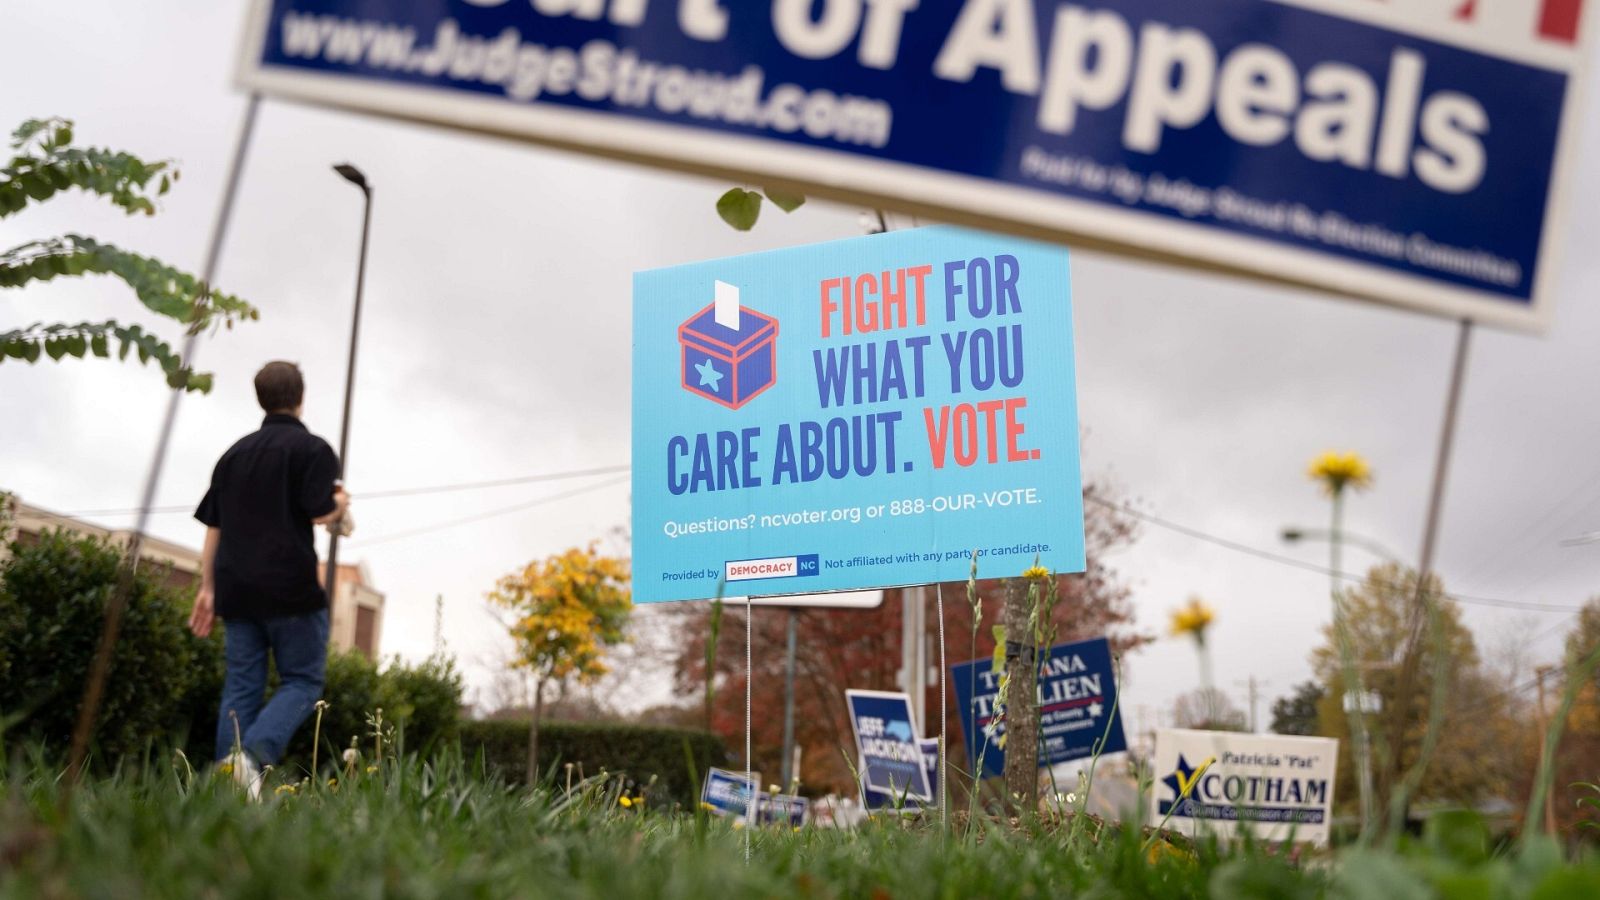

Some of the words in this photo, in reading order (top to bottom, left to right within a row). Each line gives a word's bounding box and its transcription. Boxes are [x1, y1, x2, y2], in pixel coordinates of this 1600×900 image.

[281, 14, 892, 148] www.JudgeStroud.com
[934, 0, 1490, 193] Appeals
[820, 265, 933, 339] FIGHT
[944, 254, 1023, 322] FOR
[813, 335, 932, 408] WHAT
[941, 324, 1024, 394] YOU
[667, 427, 762, 496] CARE
[772, 410, 914, 486] ABOUT.
[923, 397, 1041, 470] VOTE.
[664, 514, 756, 538] Questions?
[761, 507, 861, 528] ncvoter.org
[866, 504, 885, 518] or
[890, 488, 1042, 516] 888-OUR-VOTE.
[662, 569, 705, 582] Provided
[707, 568, 720, 580] by
[730, 562, 793, 576] DEMOCRACY
[800, 561, 816, 571] NC
[825, 558, 844, 569] Not
[846, 555, 893, 568] affiliated
[896, 553, 920, 563] with
[923, 552, 942, 563] any
[945, 549, 973, 562] party
[977, 549, 988, 557] or
[991, 543, 1052, 556] candidate.
[979, 654, 1087, 690] TANA
[971, 673, 1102, 718] TLIEN
[1222, 752, 1280, 767] Patricia
[1203, 774, 1327, 804] COTHAM
